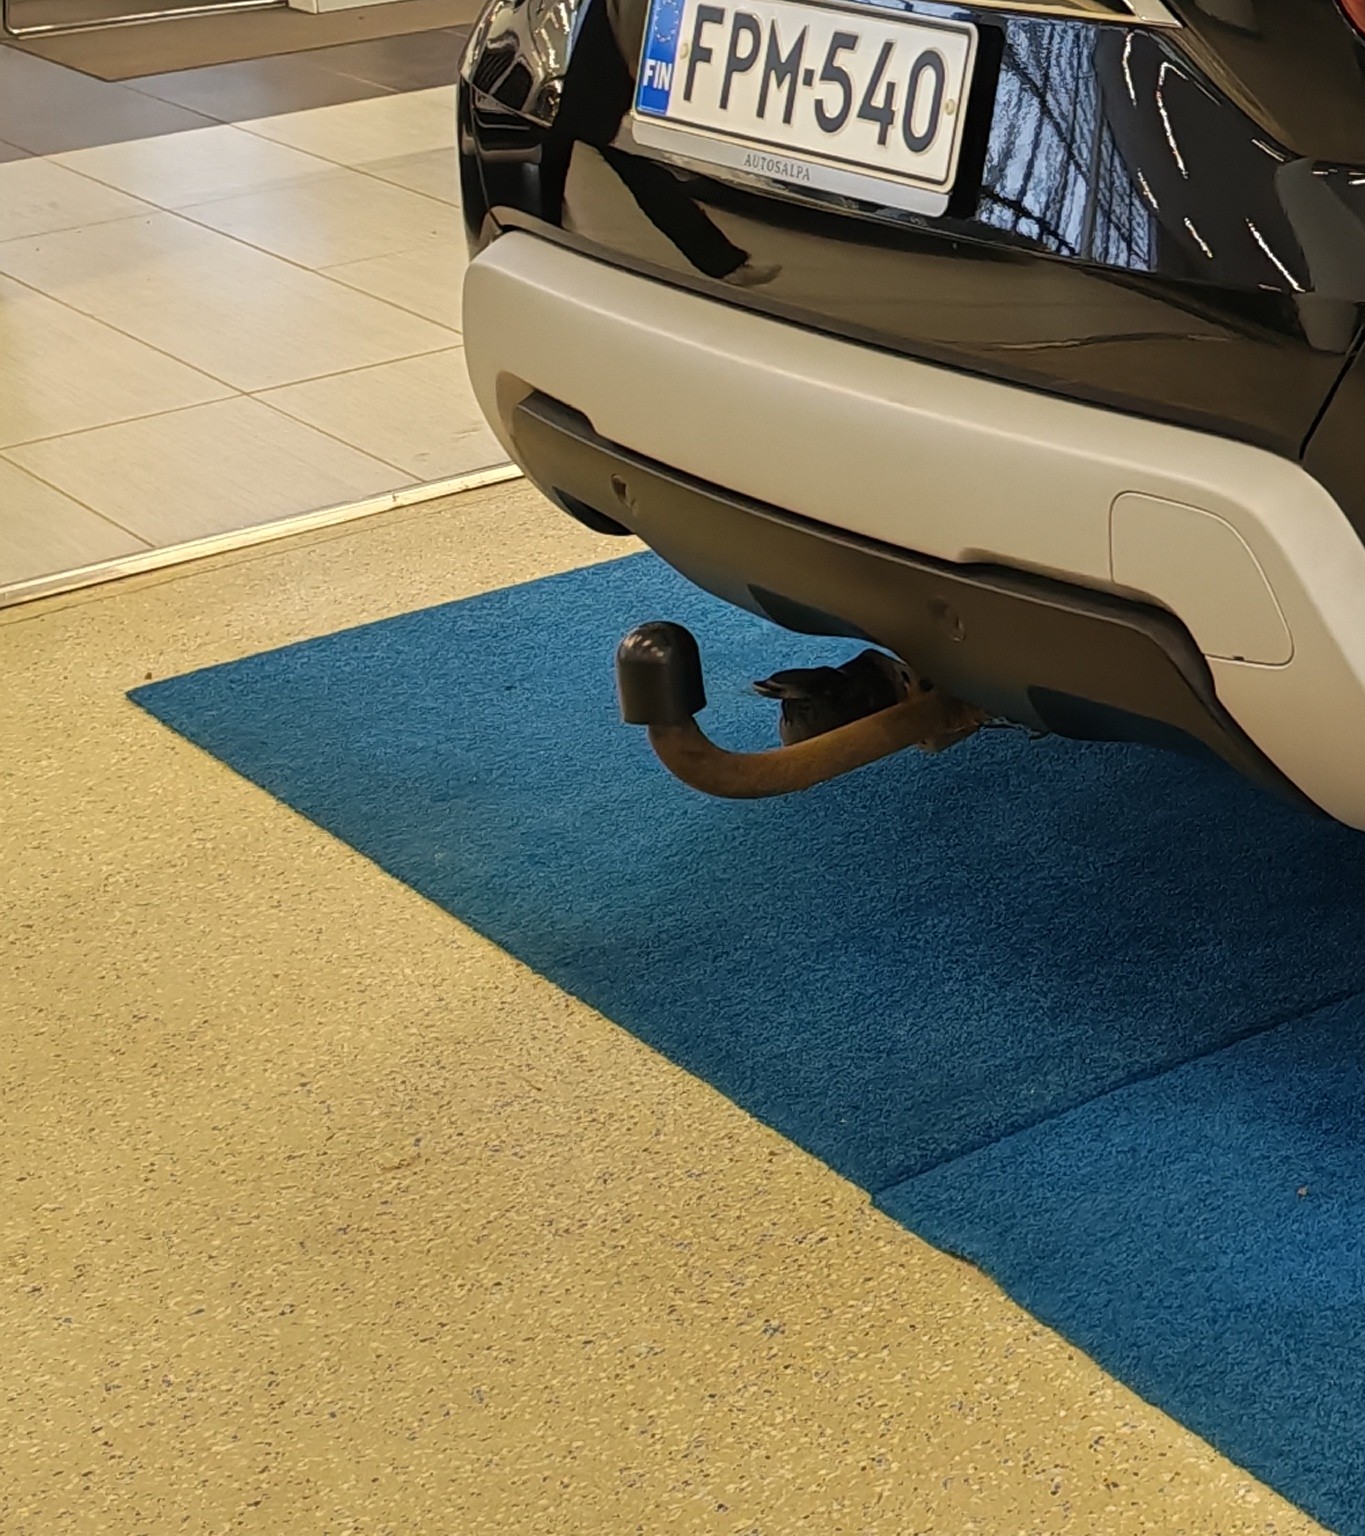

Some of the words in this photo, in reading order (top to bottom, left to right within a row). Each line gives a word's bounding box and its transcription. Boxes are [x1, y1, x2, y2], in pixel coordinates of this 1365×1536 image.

[642, 58, 673, 91] FIN
[683, 3, 946, 154] FPM-540
[743, 153, 811, 182] AUTOSALPA
